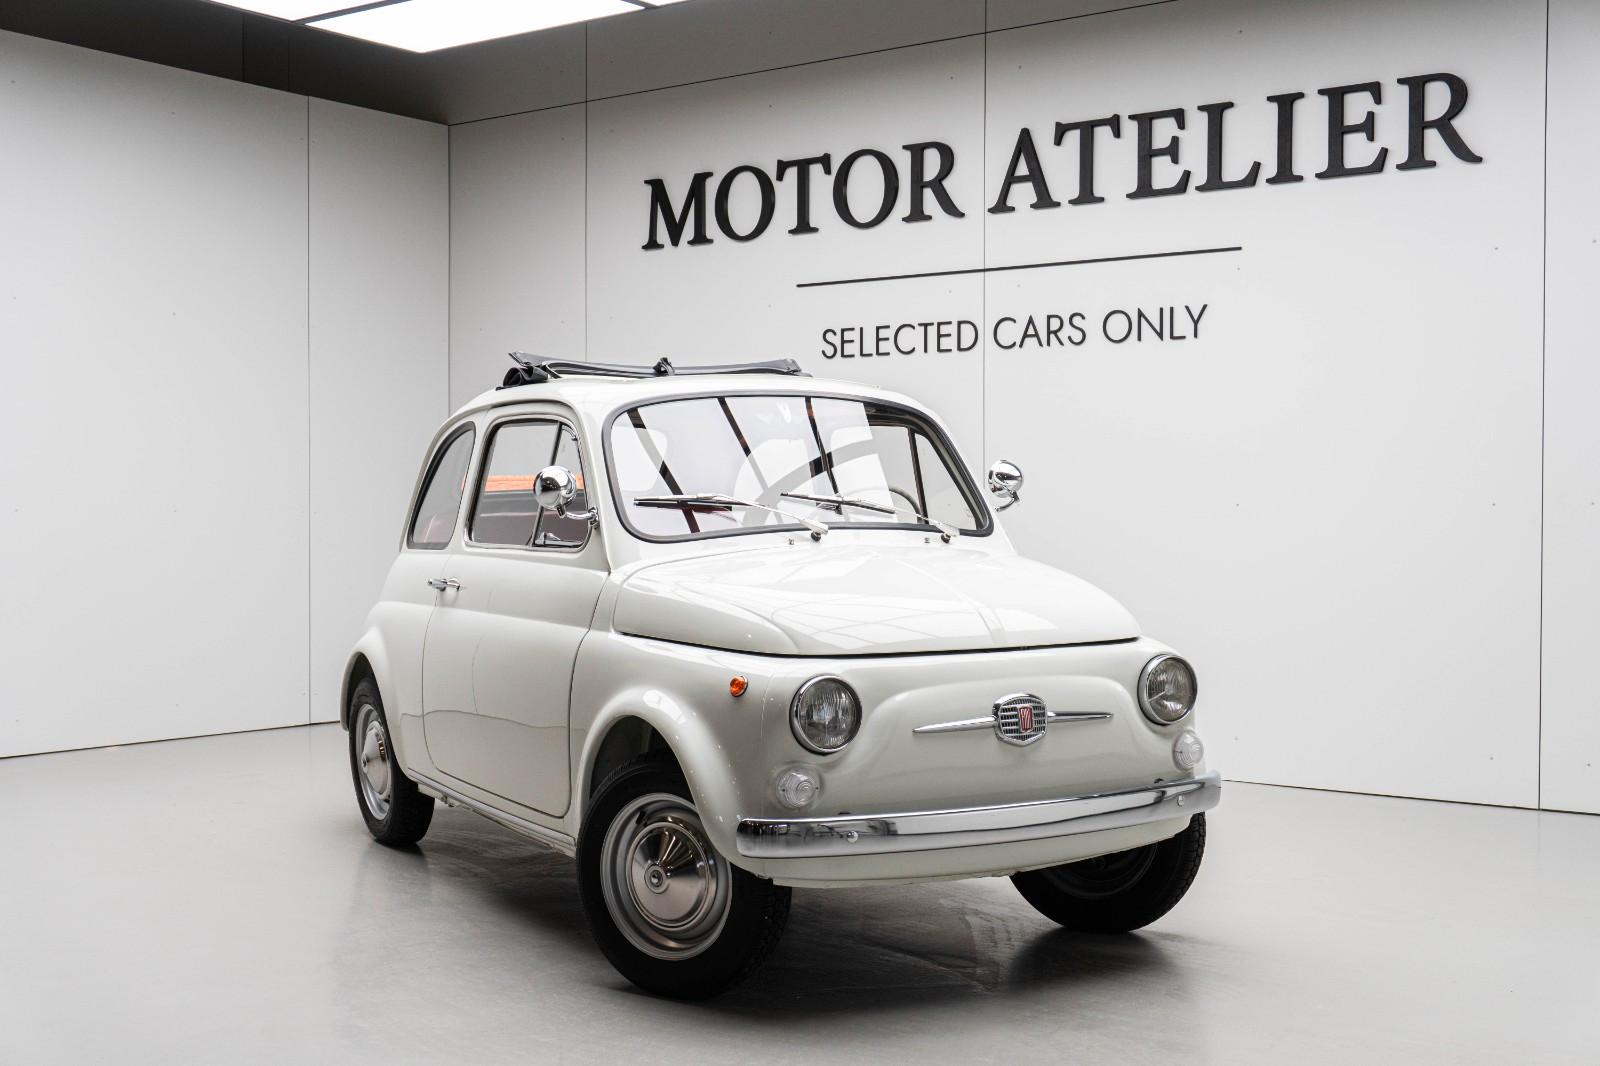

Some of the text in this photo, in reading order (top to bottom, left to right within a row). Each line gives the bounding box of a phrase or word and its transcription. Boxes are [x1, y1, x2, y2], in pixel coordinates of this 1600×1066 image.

[642, 72, 1484, 251] MOTOR ATELIER
[821, 303, 1208, 360] SELECTED CARS ONLY
